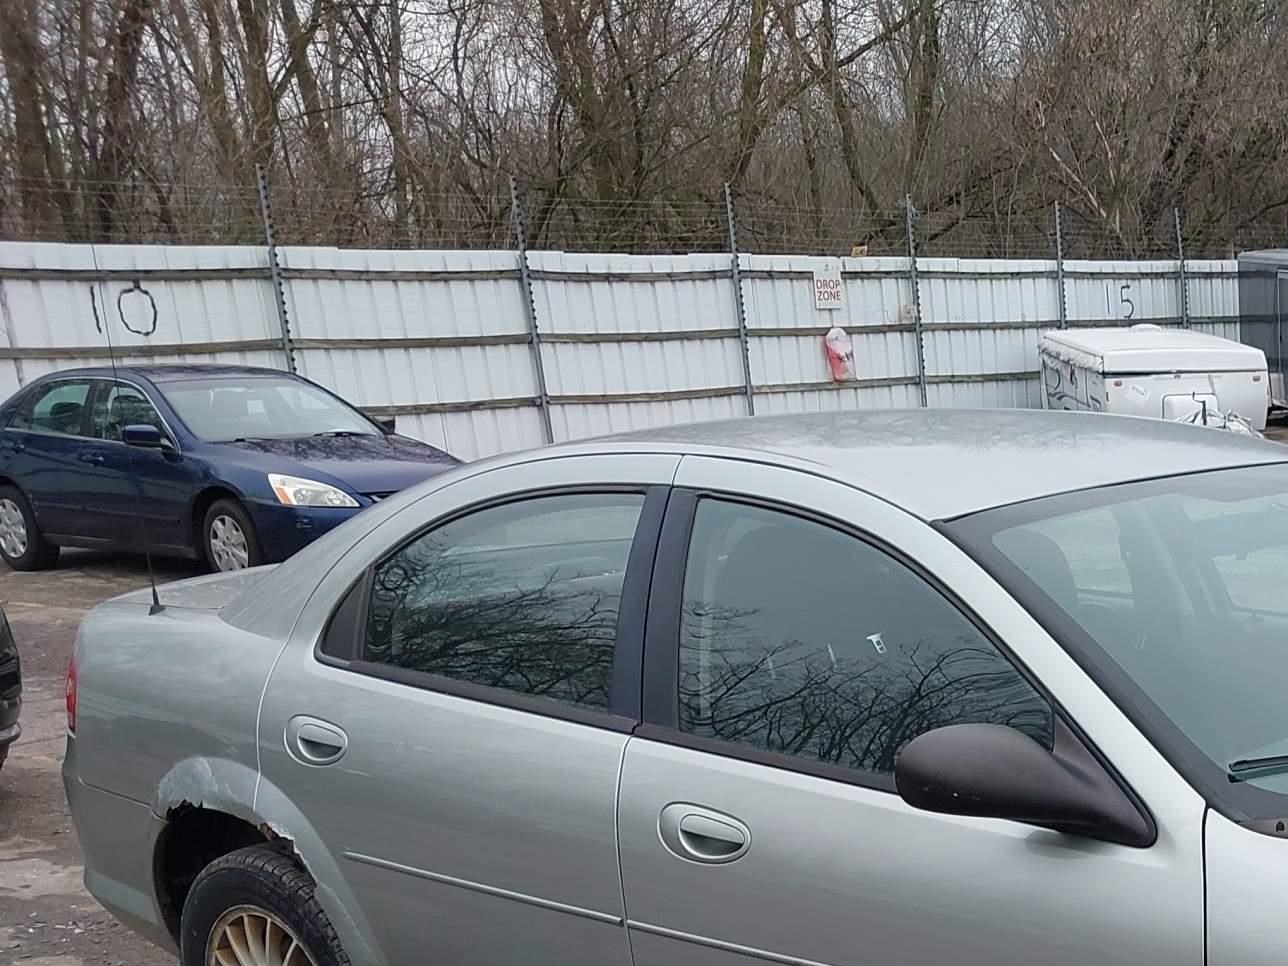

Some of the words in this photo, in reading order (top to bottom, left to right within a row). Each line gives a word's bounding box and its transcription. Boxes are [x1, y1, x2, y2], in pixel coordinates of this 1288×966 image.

[815, 279, 840, 290] DROP
[816, 290, 841, 301] ZONE
[1105, 284, 1135, 320] 15
